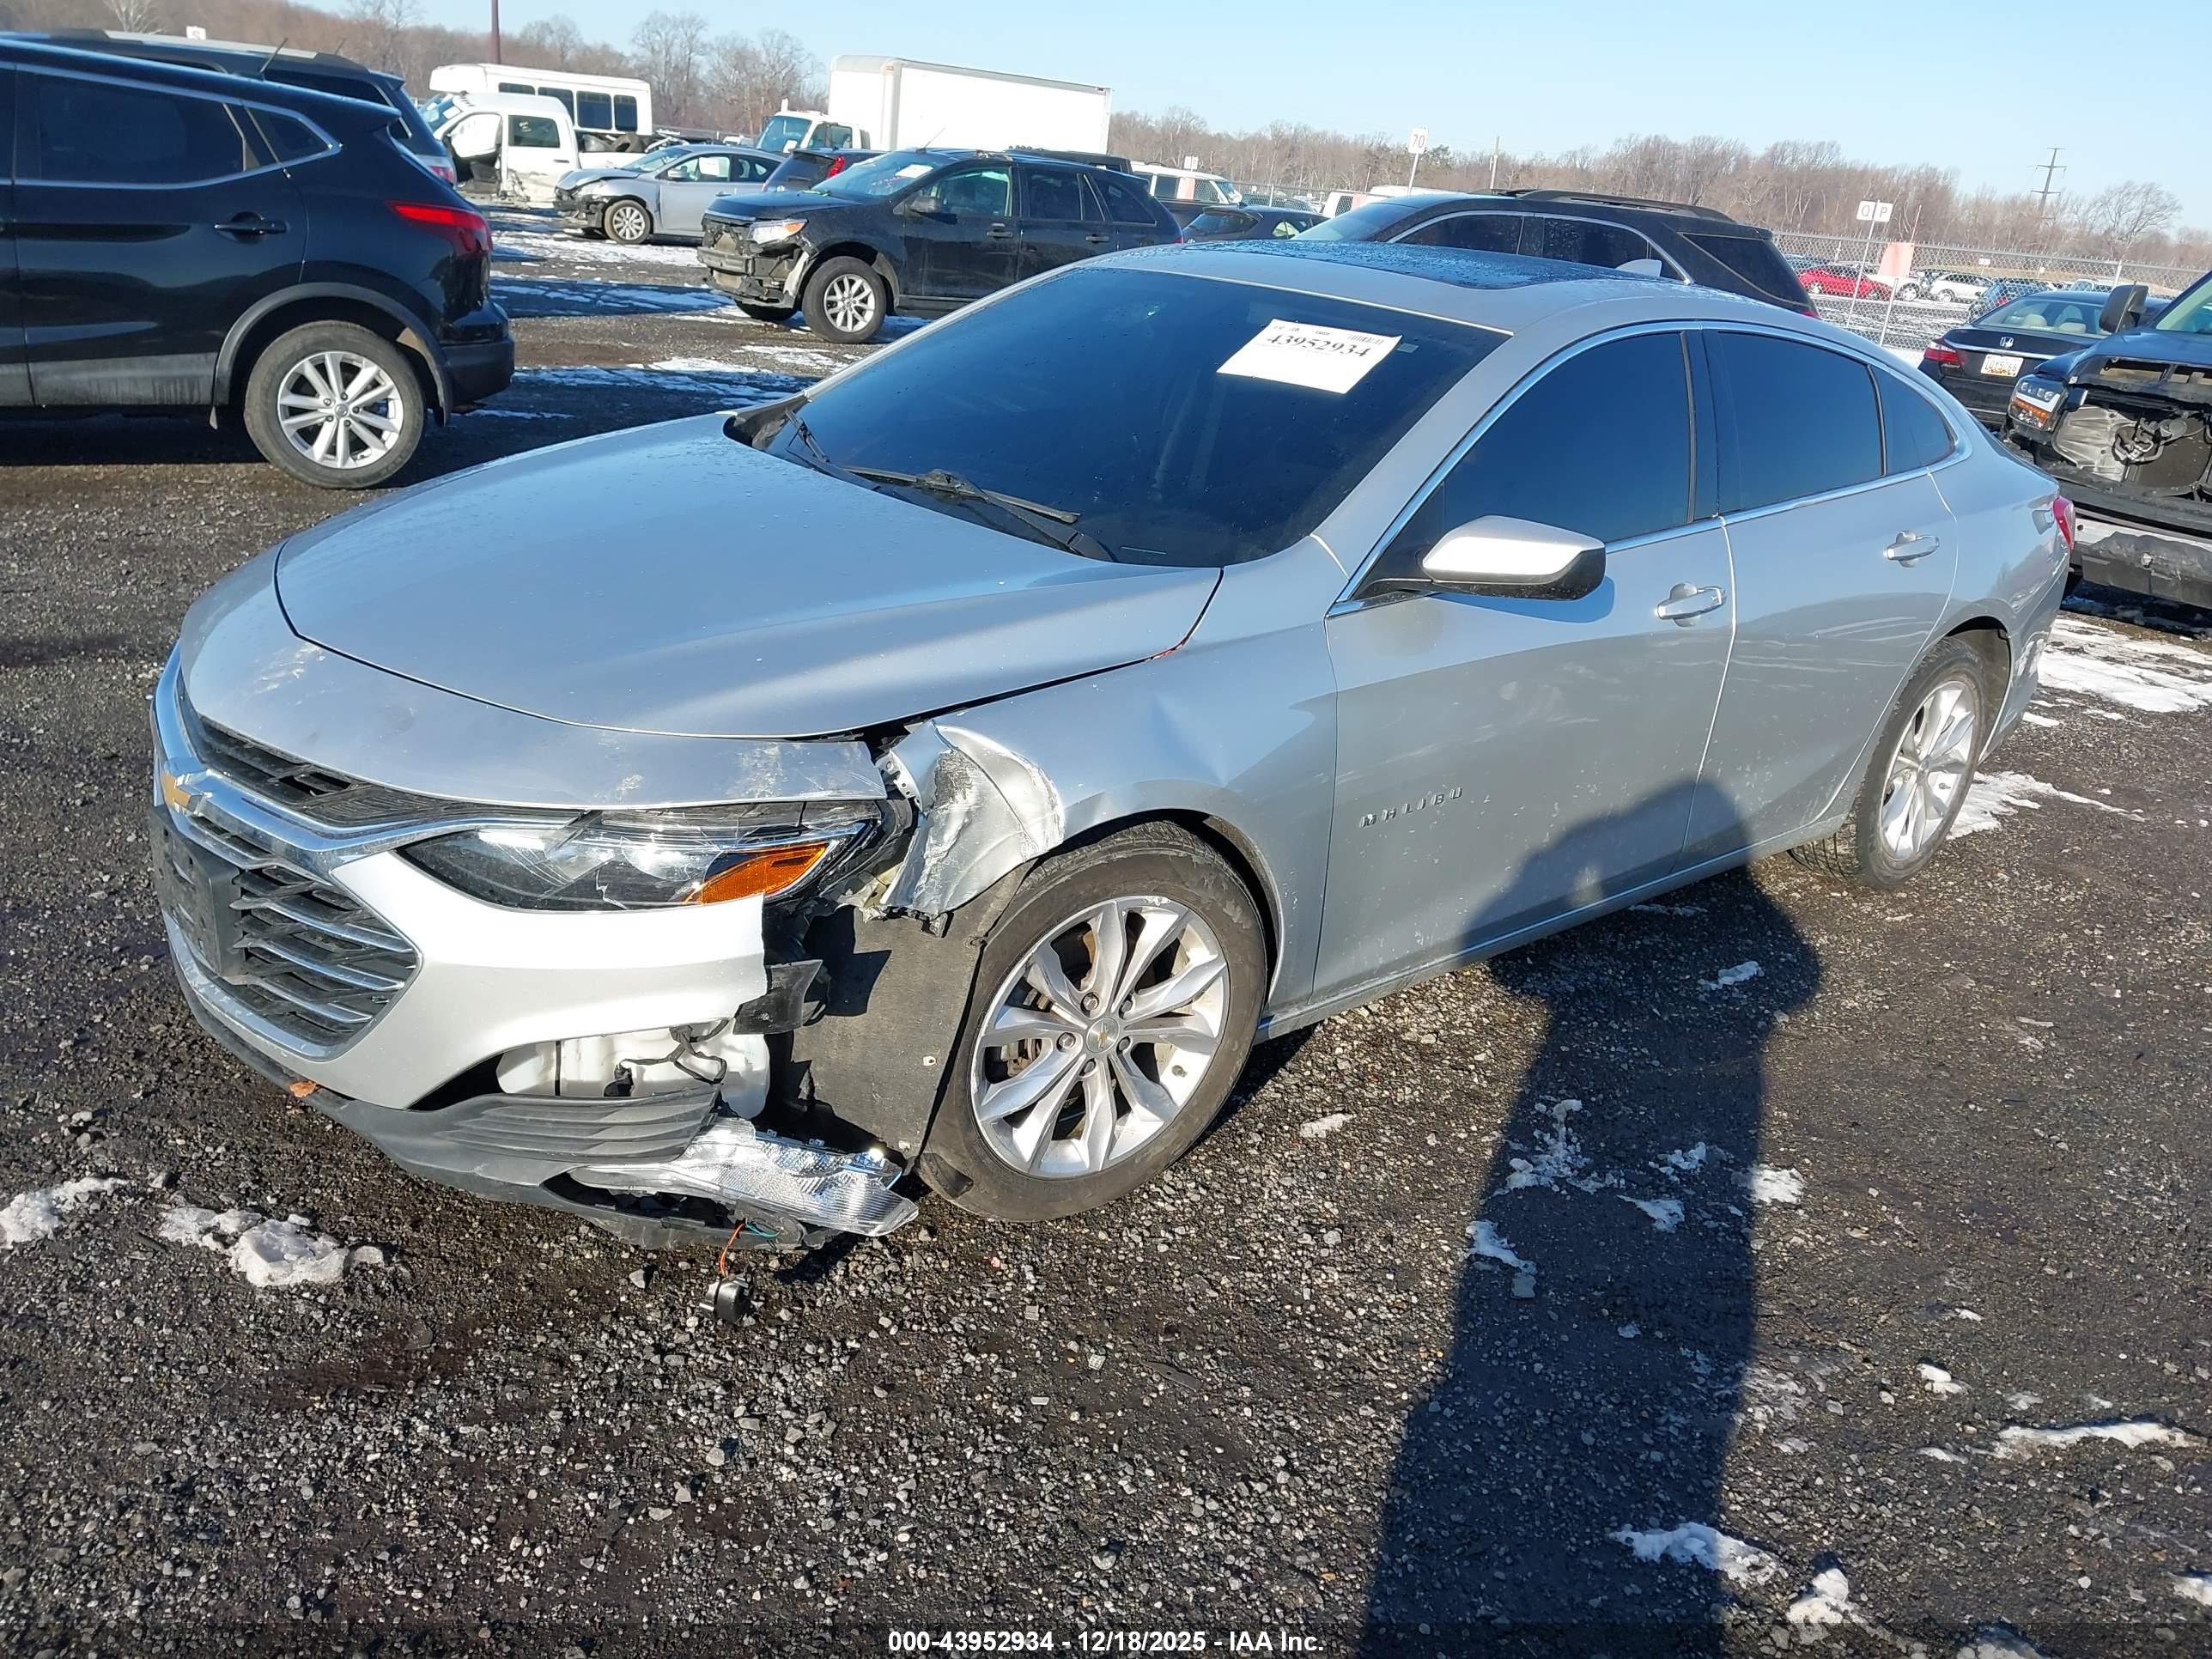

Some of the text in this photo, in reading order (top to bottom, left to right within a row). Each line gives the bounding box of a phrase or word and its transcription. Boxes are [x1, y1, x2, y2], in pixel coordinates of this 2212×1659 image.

[1412, 133, 1425, 149] 70
[1861, 204, 1871, 217] Q
[1879, 206, 1888, 219] P
[1267, 333, 1372, 357] 43952934
[1358, 787, 1463, 829] MALIBU
